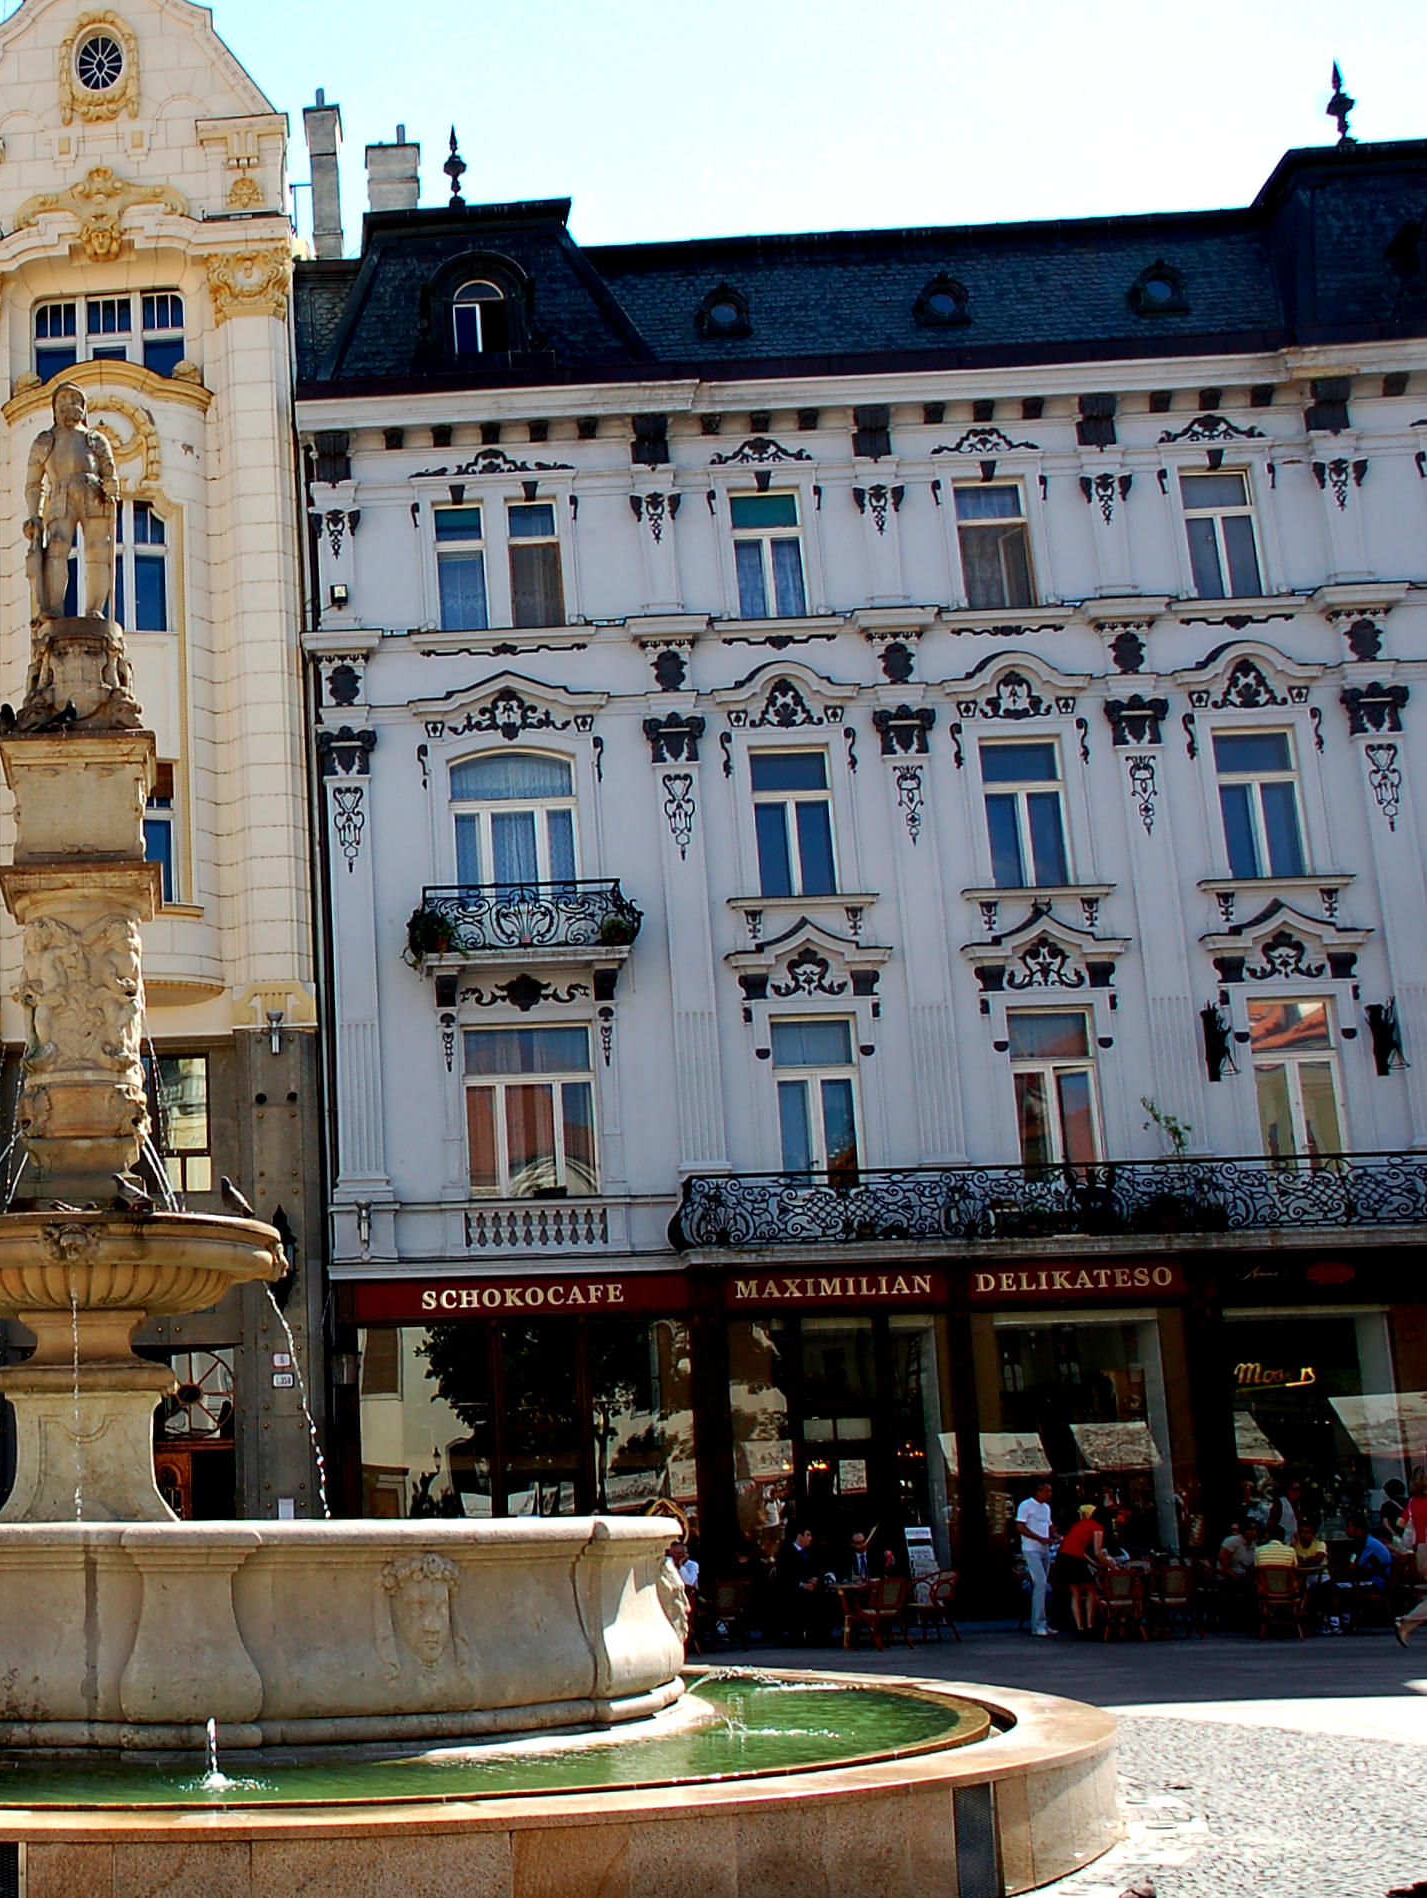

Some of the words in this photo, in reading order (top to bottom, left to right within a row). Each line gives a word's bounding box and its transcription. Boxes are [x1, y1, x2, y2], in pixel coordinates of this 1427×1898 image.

[735, 1275, 931, 1298] MAXIMILIAN
[975, 1267, 1172, 1292] DELIKATESO
[422, 1284, 624, 1310] SCHOKOCAFE
